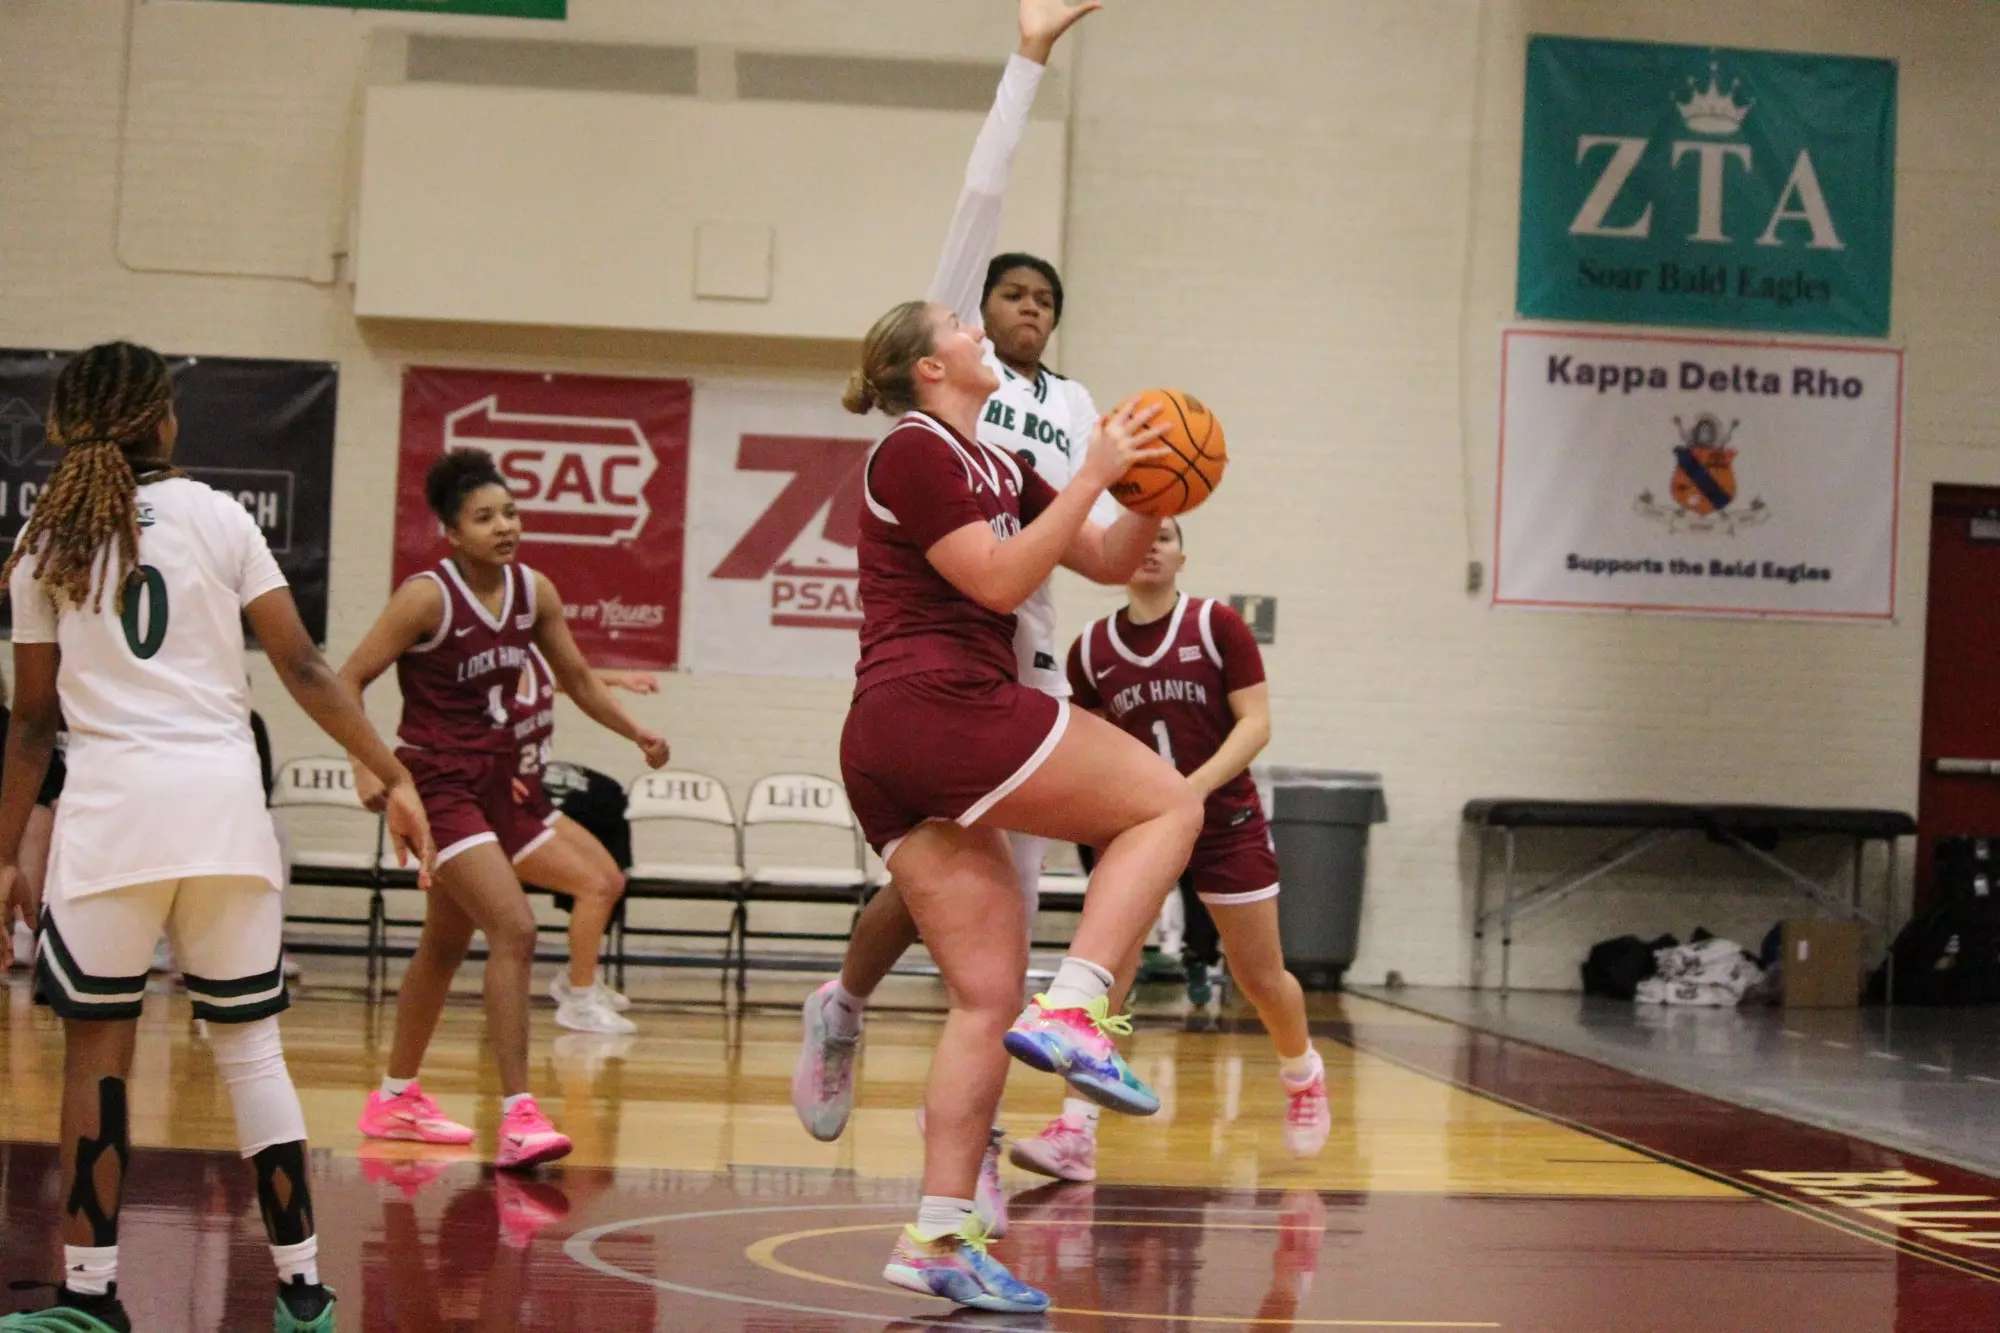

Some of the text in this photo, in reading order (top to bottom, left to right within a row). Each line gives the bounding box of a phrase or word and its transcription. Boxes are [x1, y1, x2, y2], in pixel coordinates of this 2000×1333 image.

[1568, 134, 1846, 251] ZTA
[1577, 257, 1833, 308] Soar Bald Eagles
[1547, 354, 1864, 399] Kappa Delta Rho
[500, 449, 641, 506] SAC
[1566, 553, 1831, 584] Supports the Bald Eagles
[120, 565, 169, 660] 0
[771, 579, 866, 612] PSA
[1149, 679, 1207, 705] HAVEN
[645, 779, 712, 801] LHU
[768, 784, 833, 809] LHU
